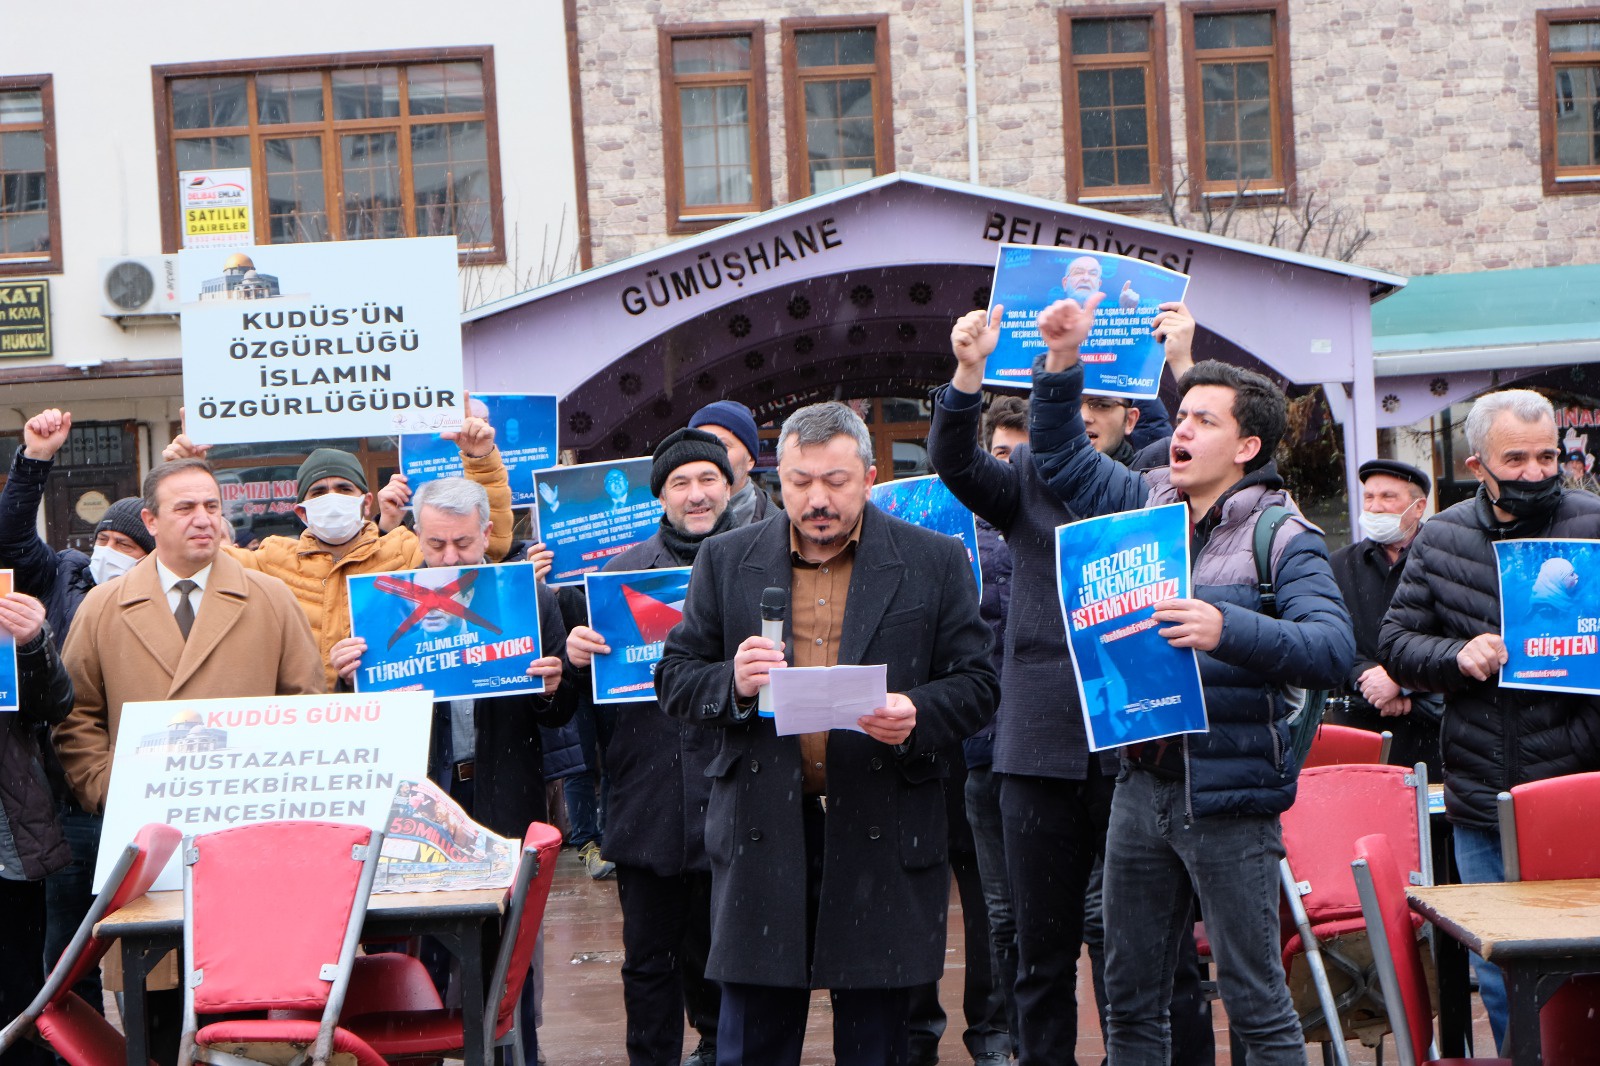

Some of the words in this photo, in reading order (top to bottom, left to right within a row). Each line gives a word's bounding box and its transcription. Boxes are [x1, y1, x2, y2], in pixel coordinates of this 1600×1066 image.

[188, 208, 246, 222] SATILIK
[621, 217, 842, 316] GÜMÜŞHANE
[9, 306, 41, 320] KAYA
[242, 302, 405, 331] KUDÜS'ÜN
[2, 332, 45, 350] HUKUK
[229, 329, 420, 360] ÖZGÜRLÜĞÜ
[260, 364, 392, 388] İSLAMIN
[1127, 377, 1155, 387] SAADET
[198, 386, 456, 420] ÖZGÜRLÜĞÜDÜR
[220, 481, 271, 501] IRMIZI
[519, 492, 535, 500] SAA
[1082, 541, 1159, 586] HERZOG'U
[1078, 559, 1166, 609] ÜLKEMİZDE
[1070, 577, 1180, 632] İSTEMİYORUZ!
[415, 631, 479, 655] ZALİMLERİN
[1526, 632, 1596, 662] GÜÇTEN
[365, 650, 461, 685] TÜRKİYE'DE
[465, 641, 488, 668] İŞİ
[492, 635, 533, 660] YOK!
[500, 674, 533, 685] SAADET
[206, 704, 299, 728] KUDÜS
[305, 700, 382, 725] GÜNÜ
[1149, 694, 1182, 708] SAADET
[164, 746, 381, 773] MUSTAZAFLARI
[144, 768, 394, 799] MÜSTEKBİRLERİN
[165, 799, 367, 824] PENÇESİNDEN
